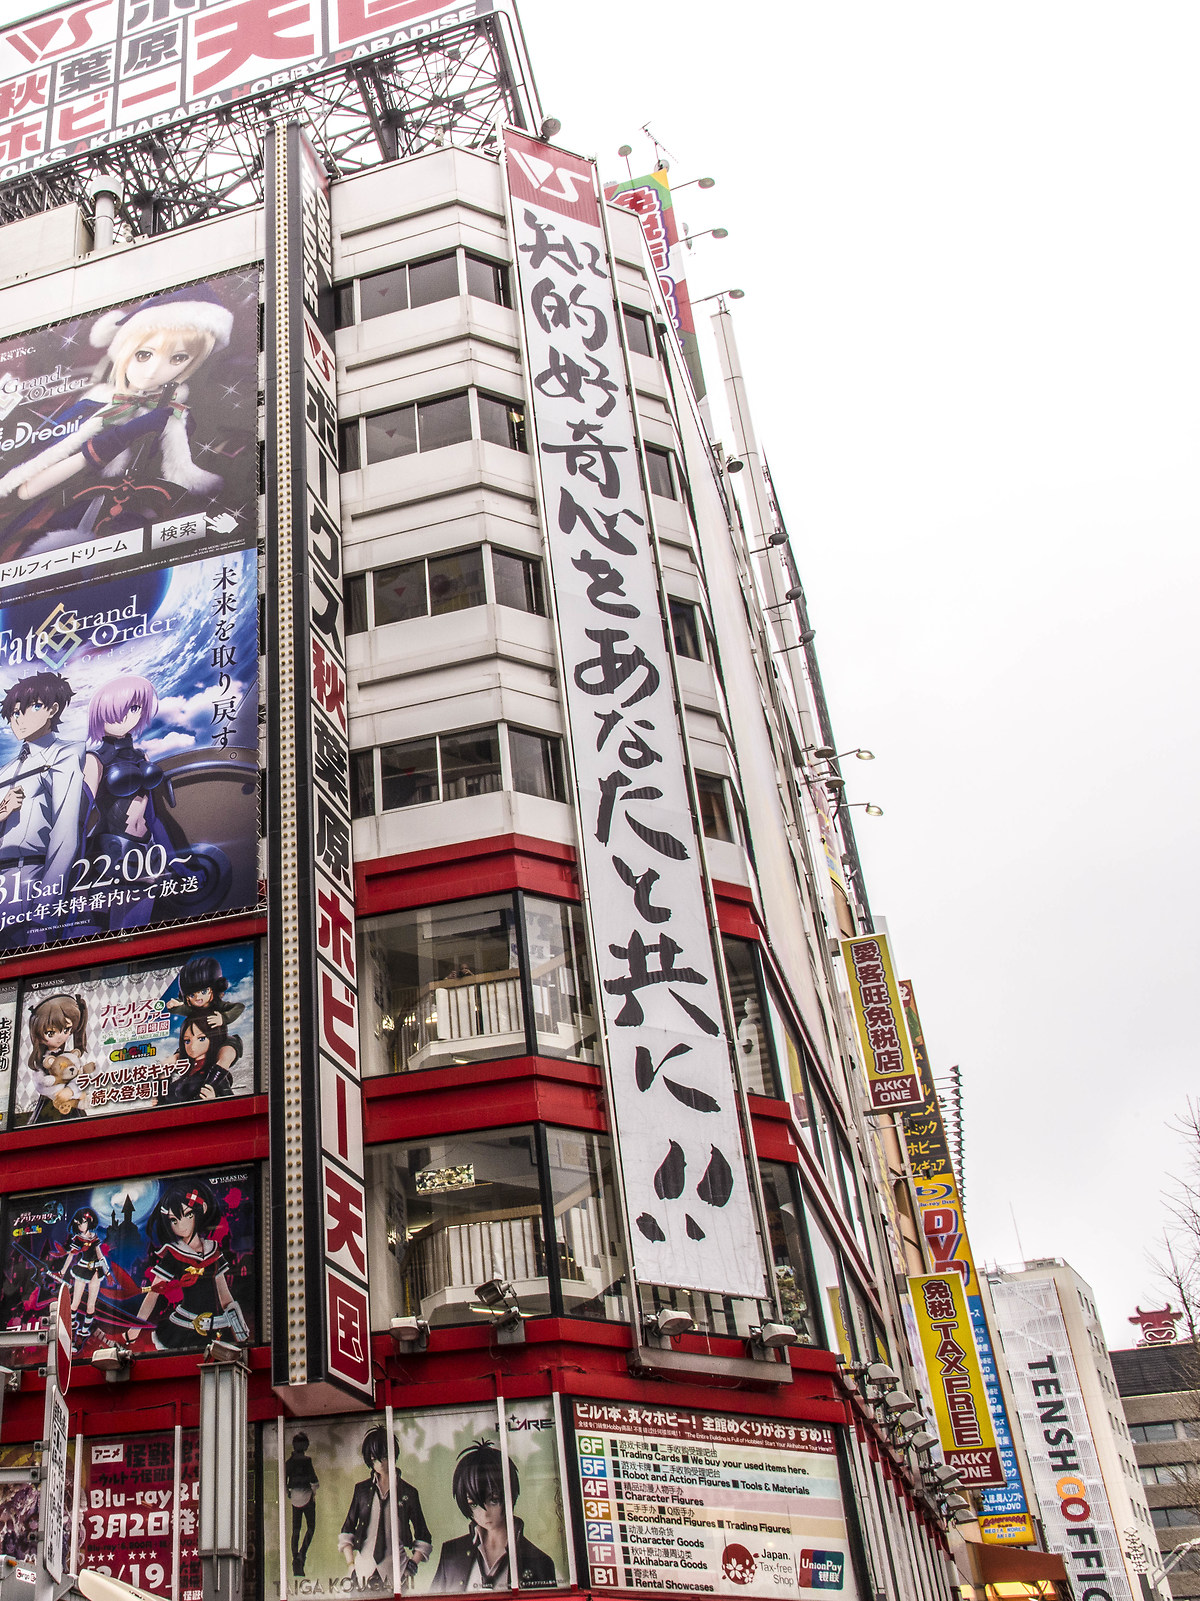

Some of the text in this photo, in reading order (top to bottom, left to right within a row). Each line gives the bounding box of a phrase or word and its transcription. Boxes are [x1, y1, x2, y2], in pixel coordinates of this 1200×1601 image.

[74, 95, 224, 154] AKIHABARA
[232, 57, 328, 100] HOBBY
[334, 6, 479, 63] PARADISE
[1, 364, 62, 394] Grand
[26, 375, 90, 401] Order
[159, 520, 198, 542] 検索
[0, 540, 129, 582] ドルフィードリーム
[50, 594, 141, 634] Grand
[87, 613, 177, 648] Order
[101, 1011, 171, 1029] パンツァー
[76, 1059, 192, 1090] ライバル校キャラ
[90, 1080, 170, 1106] 続々登場!!
[873, 1077, 913, 1093] AKKY
[879, 1089, 912, 1103] ONE
[907, 1140, 941, 1157] ホビー
[921, 1279, 957, 1320] 免税
[931, 1320, 984, 1448] TAX FREE
[94, 1447, 121, 1460] アニメ
[580, 1437, 602, 1454] 6F
[620, 1449, 810, 1476] Trading Cards We buy your used items here.
[950, 1451, 992, 1466] AKKY
[582, 1459, 604, 1476] 5F
[958, 1465, 992, 1479] ONE
[583, 1480, 607, 1497] 4F
[622, 1470, 650, 1480] Robot
[650, 1472, 668, 1482] and
[668, 1475, 697, 1485] Action
[698, 1476, 731, 1488] Figures
[740, 1480, 763, 1491] Tools
[772, 1483, 810, 1495] Materials
[90, 1488, 173, 1509] Blu-ray
[624, 1491, 705, 1507] Character Figures
[585, 1501, 609, 1518] 3F
[587, 1523, 612, 1540] 2F
[627, 1512, 791, 1535] Secondhand Figures Trading Figures
[629, 1534, 705, 1548] Character Goods
[591, 1545, 612, 1562] 1F
[761, 1548, 791, 1561] Japan.
[632, 1555, 708, 1570] Akihabara Goods
[759, 1561, 793, 1574] Tax-free
[801, 1557, 843, 1576] UnionPay
[593, 1567, 614, 1585] B1
[773, 1574, 794, 1587] Shop
[635, 1578, 714, 1592] Rental Showcases
